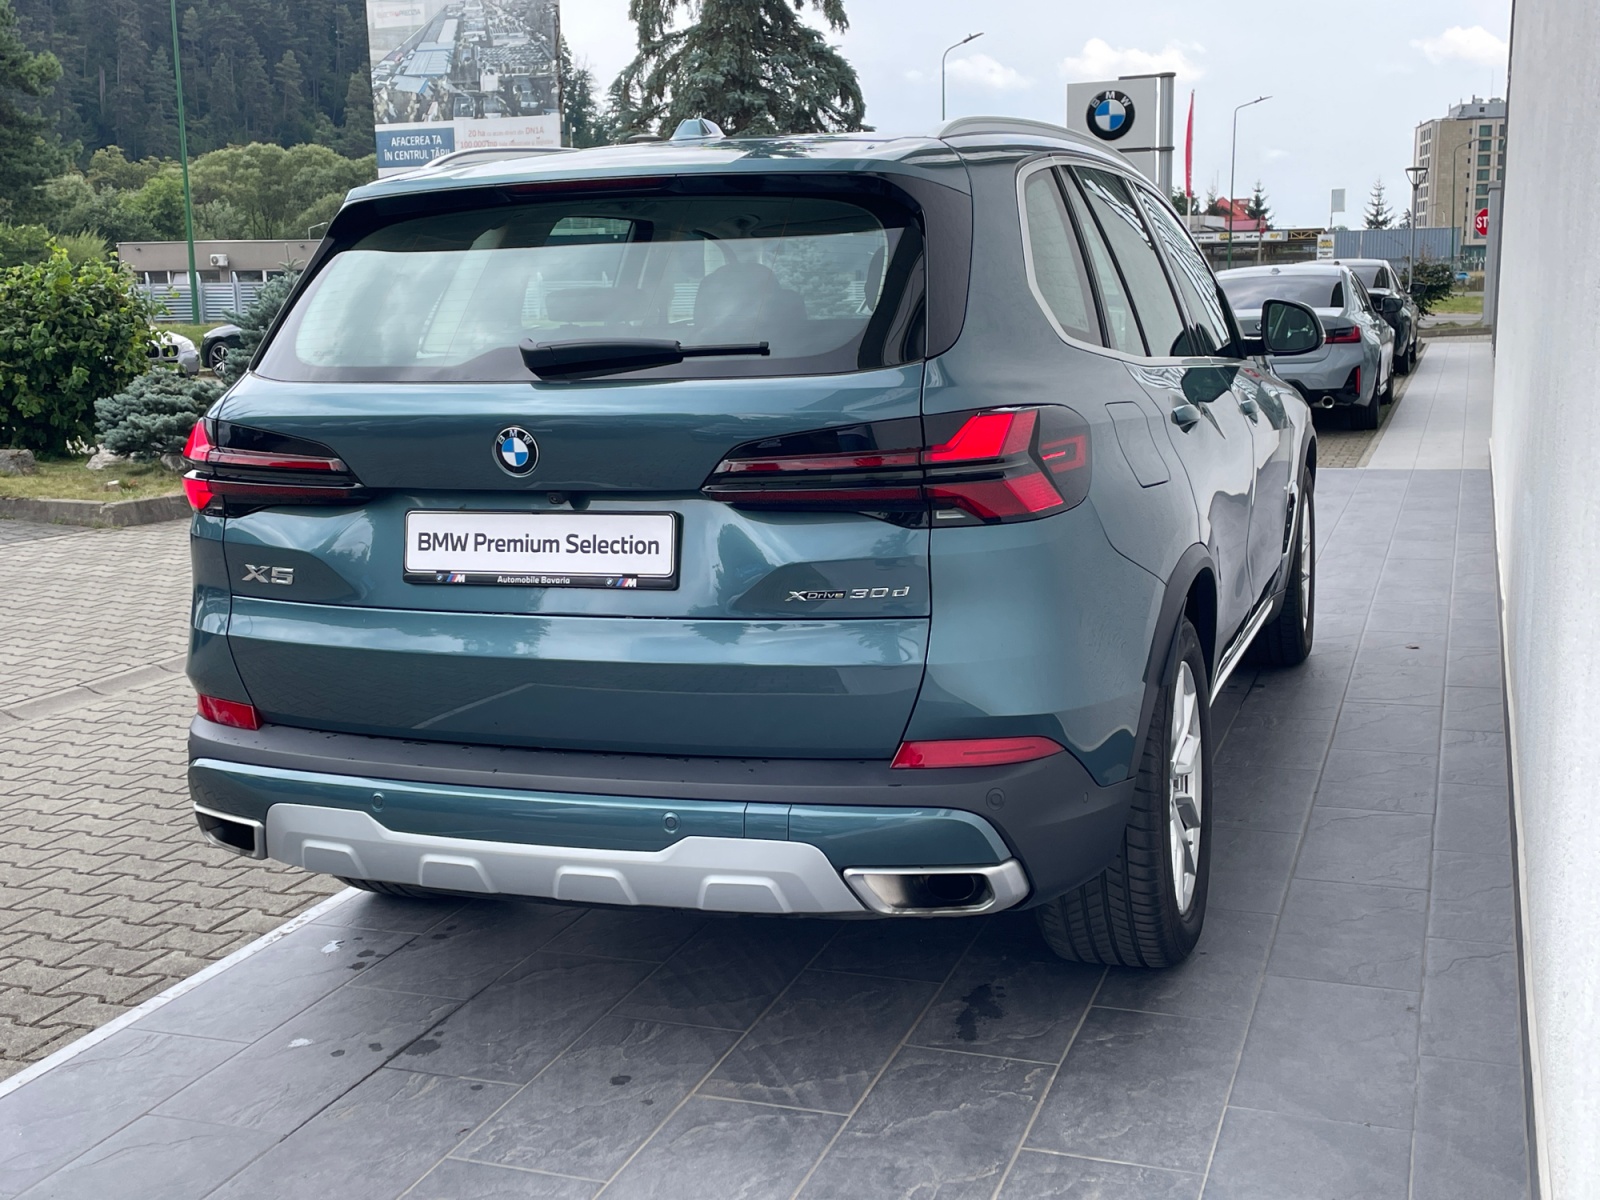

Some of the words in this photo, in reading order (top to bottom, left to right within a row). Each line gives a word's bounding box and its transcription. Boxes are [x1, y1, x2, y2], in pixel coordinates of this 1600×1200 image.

[1090, 90, 1131, 108] BMW
[391, 135, 431, 147] AFACEREA
[432, 134, 442, 145] TA
[384, 148, 393, 161] ÎN
[394, 149, 429, 161] CENTRUL
[1476, 216, 1488, 229] ST
[497, 429, 533, 445] BMW
[417, 532, 469, 551] BMW
[474, 533, 560, 554] Premium
[565, 534, 660, 555] Selection
[241, 563, 294, 585] X5
[497, 575, 540, 584] Automobile
[541, 576, 571, 585] Bavaria
